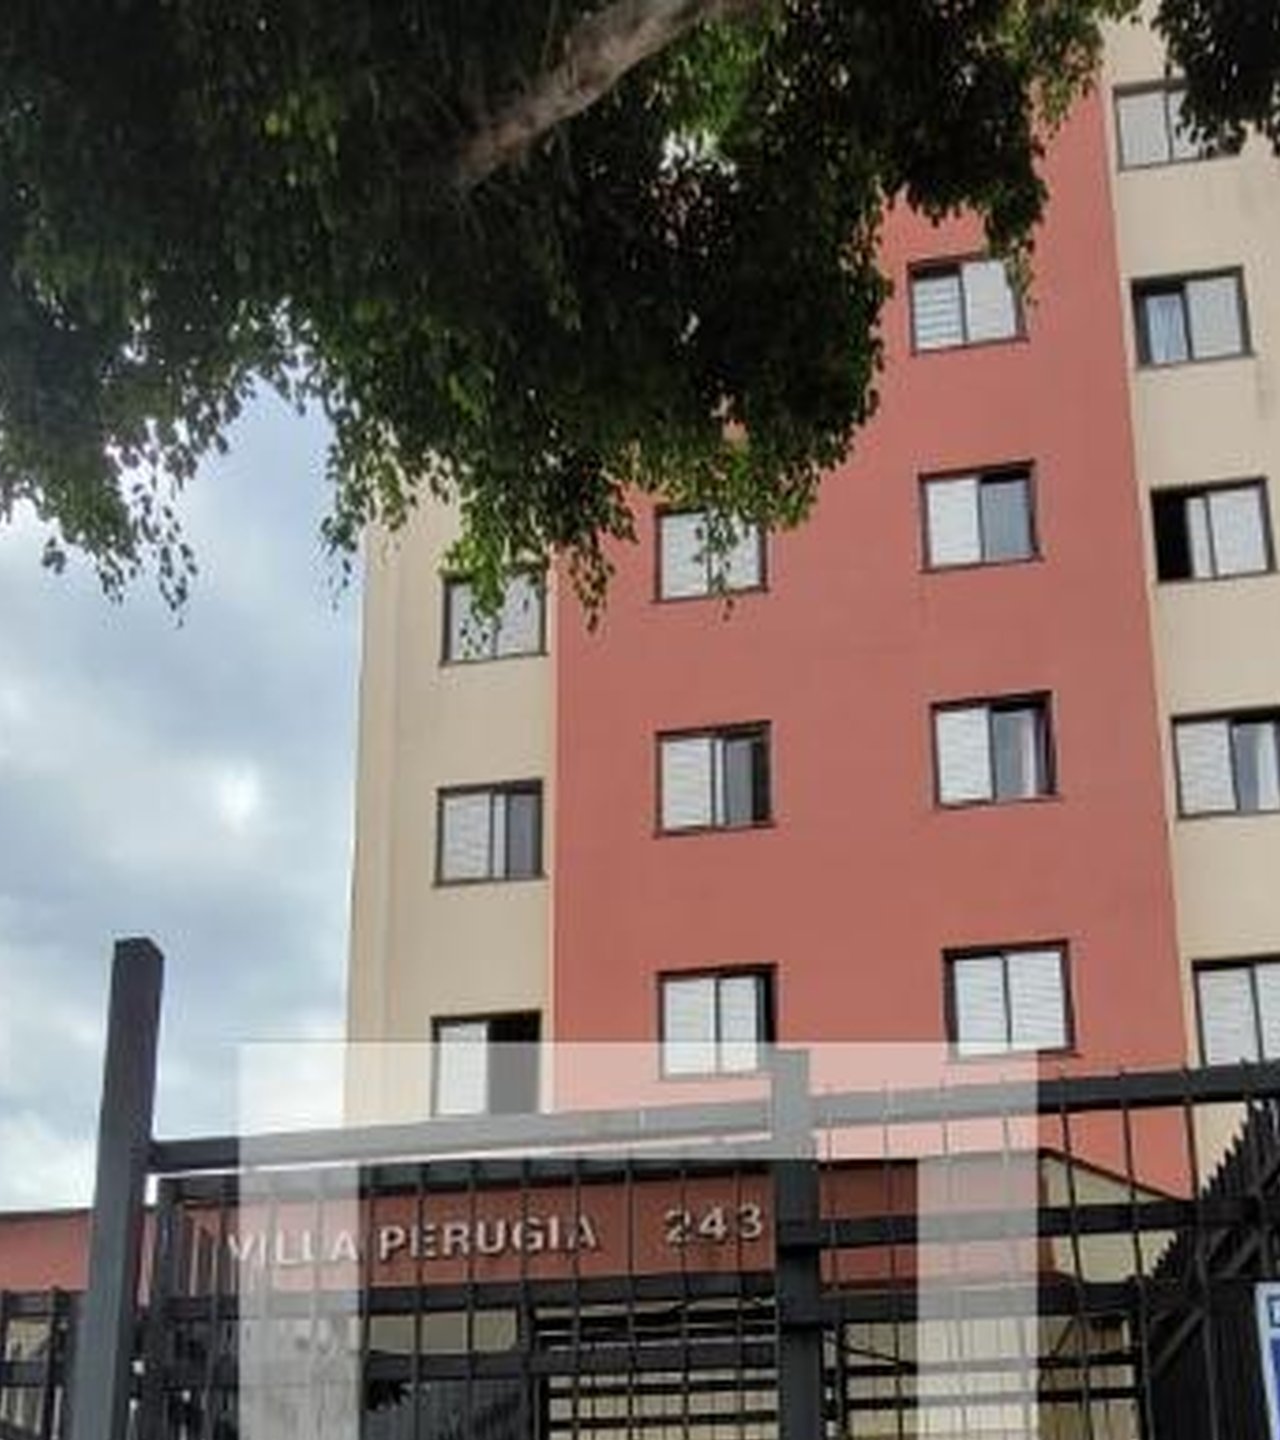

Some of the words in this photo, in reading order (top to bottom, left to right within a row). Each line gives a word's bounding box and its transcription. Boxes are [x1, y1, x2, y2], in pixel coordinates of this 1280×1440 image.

[227, 1229, 359, 1266] VILLA
[378, 1214, 596, 1261] PERUGIA
[664, 1202, 763, 1243] 243
